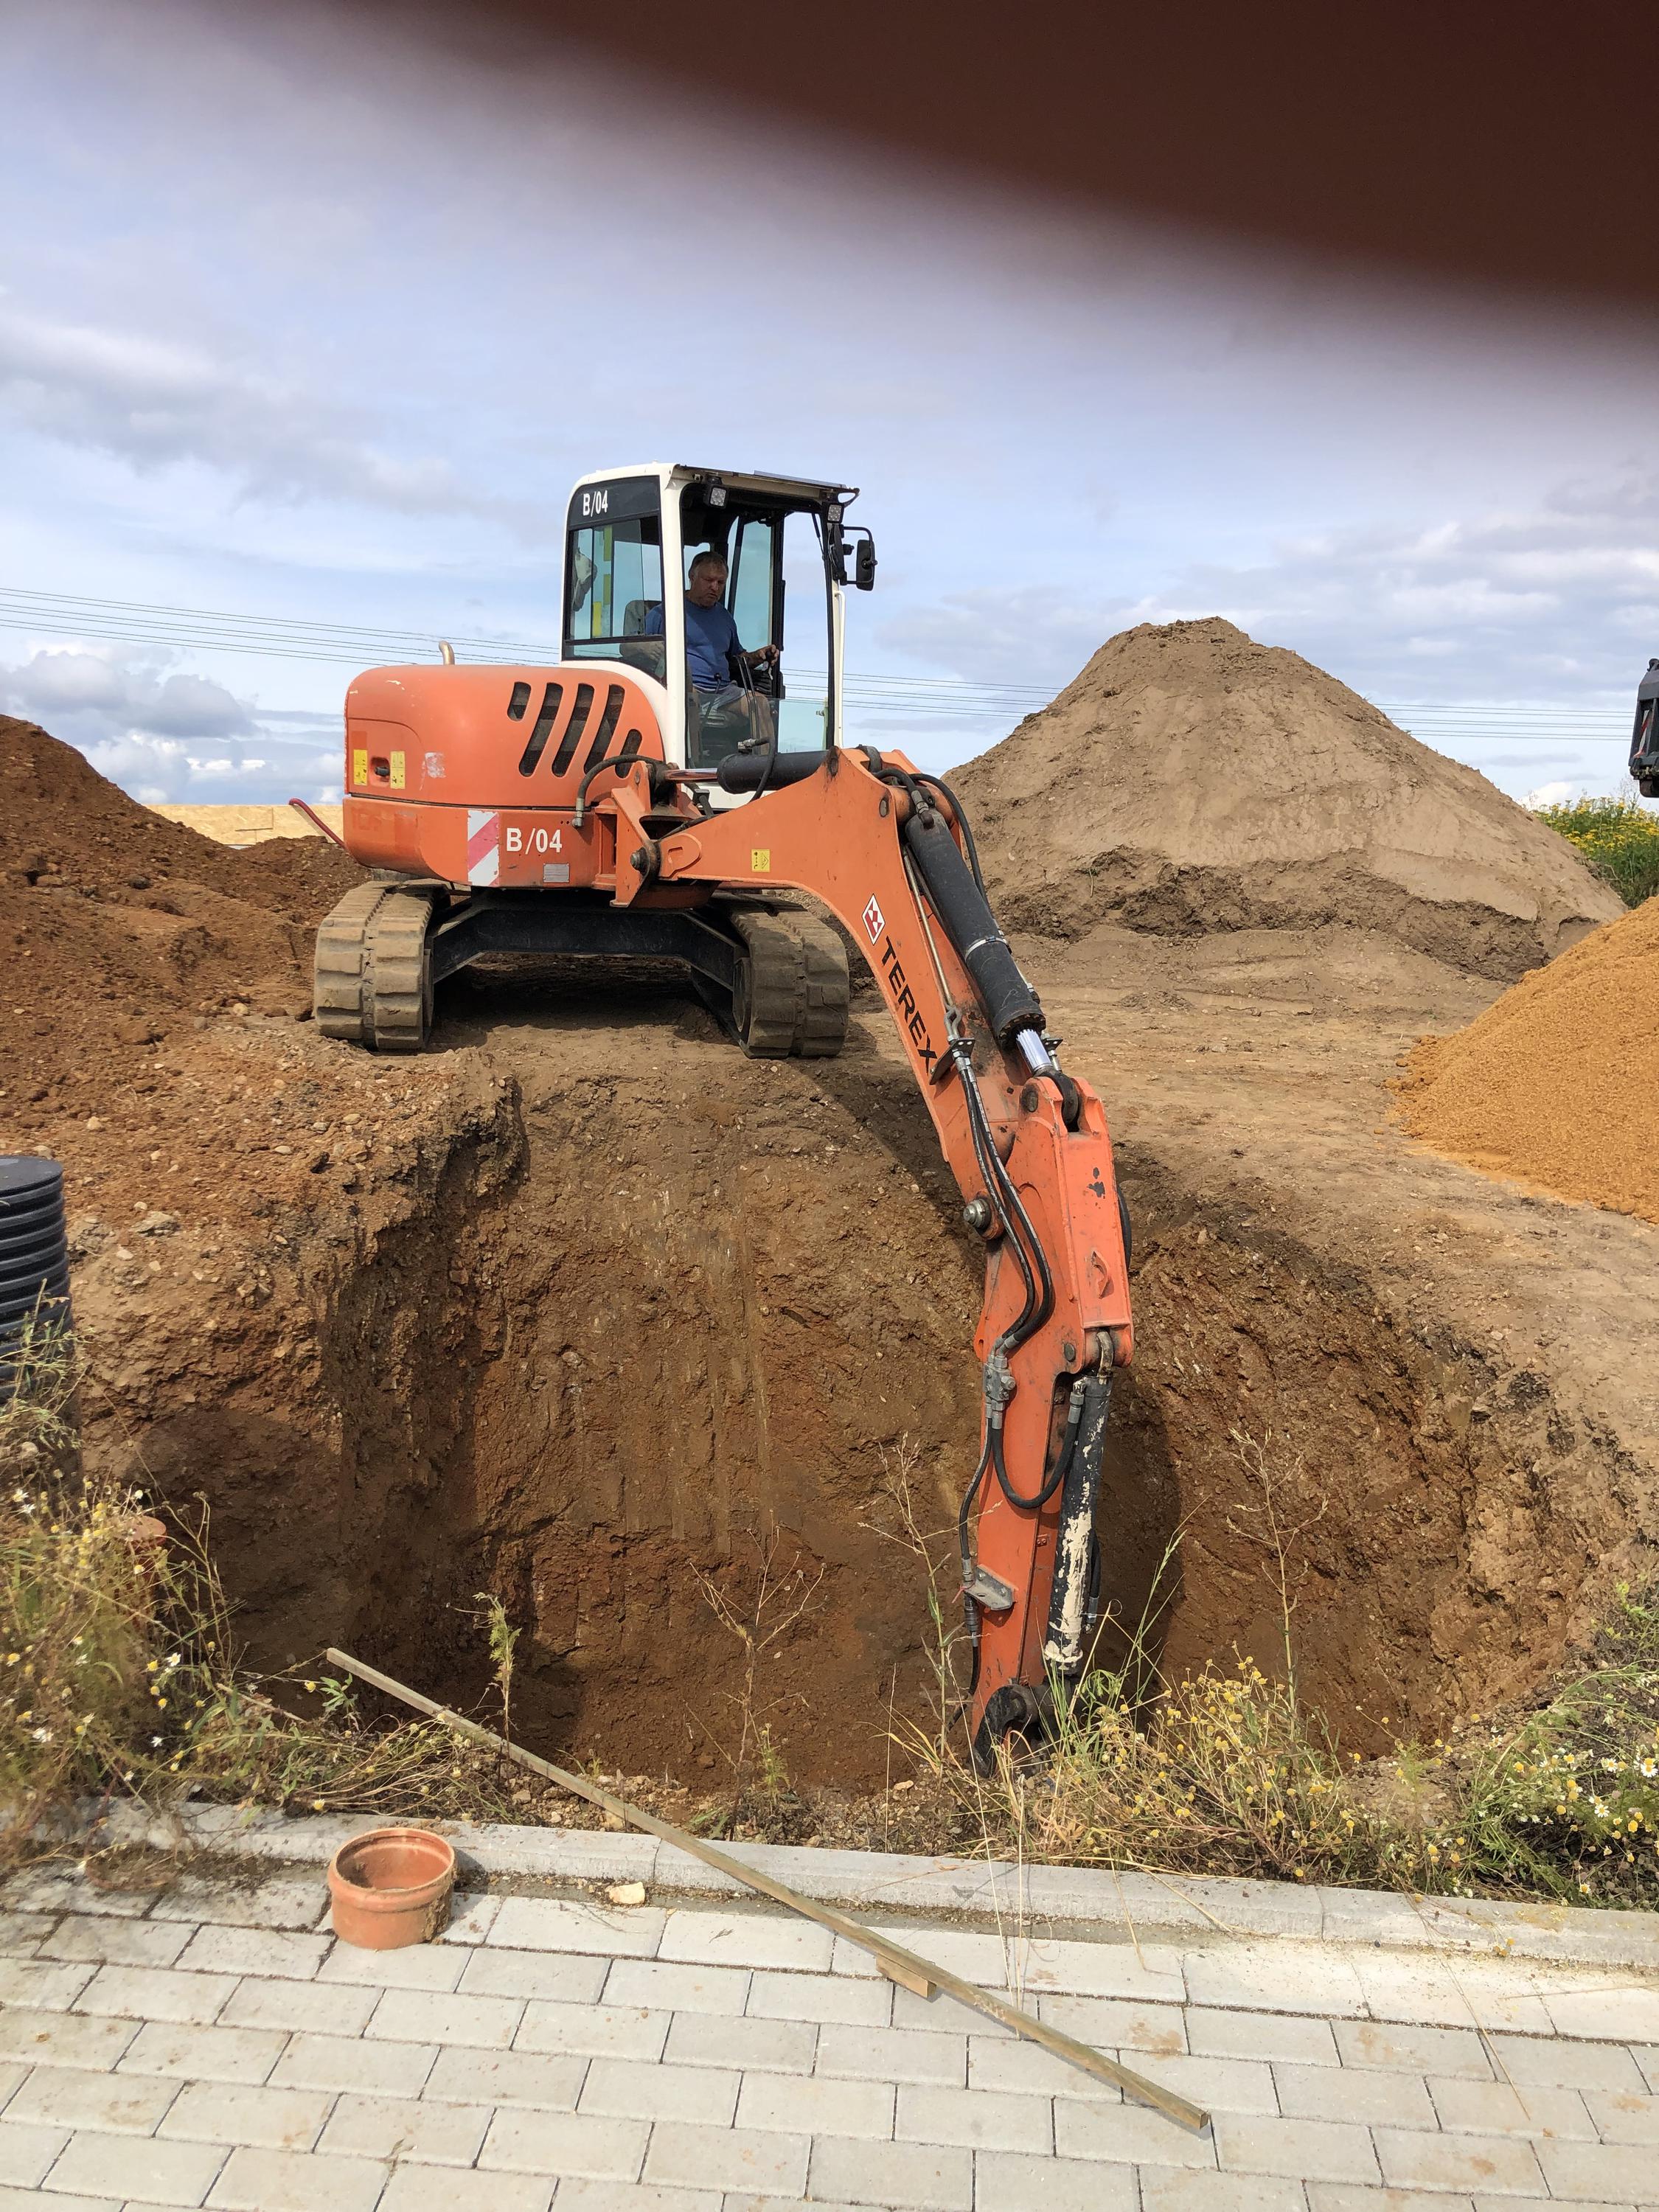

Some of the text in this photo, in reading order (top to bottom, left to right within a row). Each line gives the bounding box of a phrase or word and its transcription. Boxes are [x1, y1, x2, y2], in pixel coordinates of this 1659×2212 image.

[582, 490, 608, 517] B/04
[507, 827, 563, 855] B/04
[882, 936, 938, 1077] TEREX
